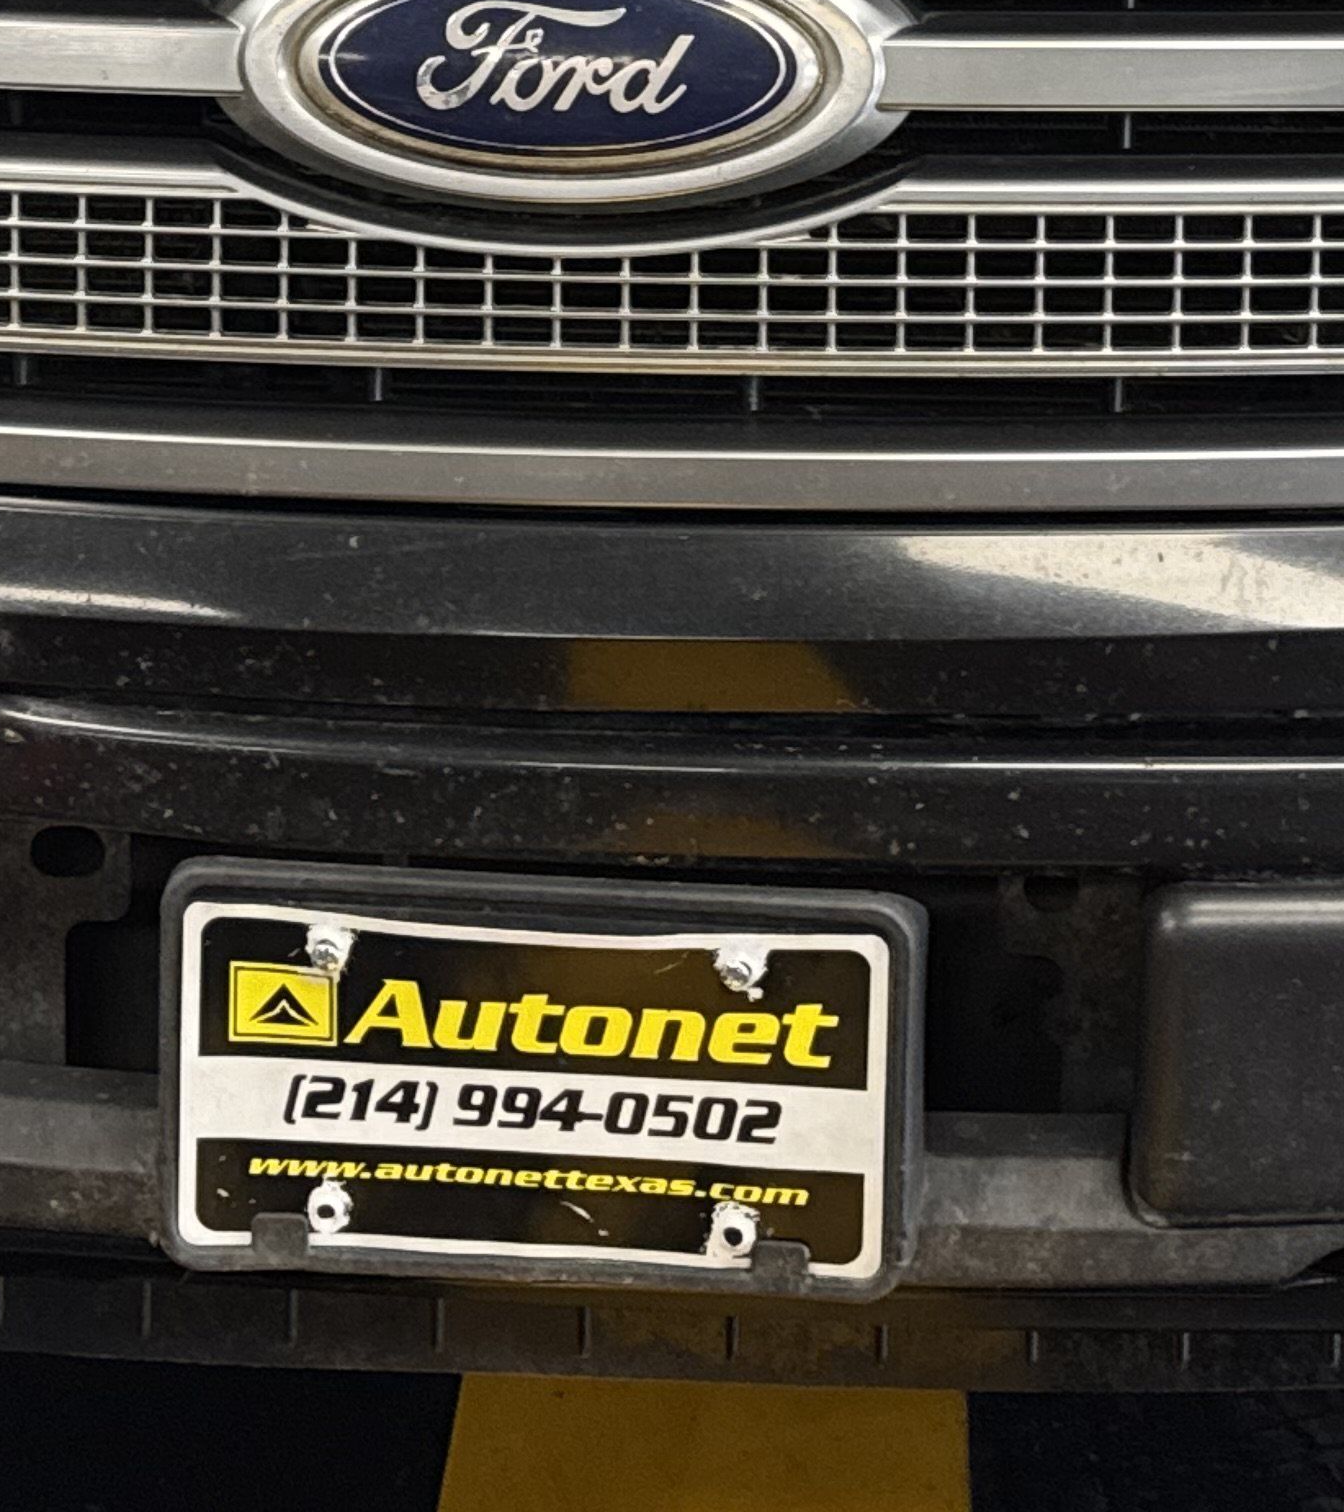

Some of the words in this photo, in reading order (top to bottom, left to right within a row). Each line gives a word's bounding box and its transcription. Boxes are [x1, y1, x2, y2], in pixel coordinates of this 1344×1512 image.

[416, 0, 695, 114] Ford
[344, 978, 839, 1069] Autonet
[283, 1074, 439, 1131] (214)
[453, 1083, 782, 1145] 994-0502
[248, 1156, 810, 1207] www.autonettexas.com
